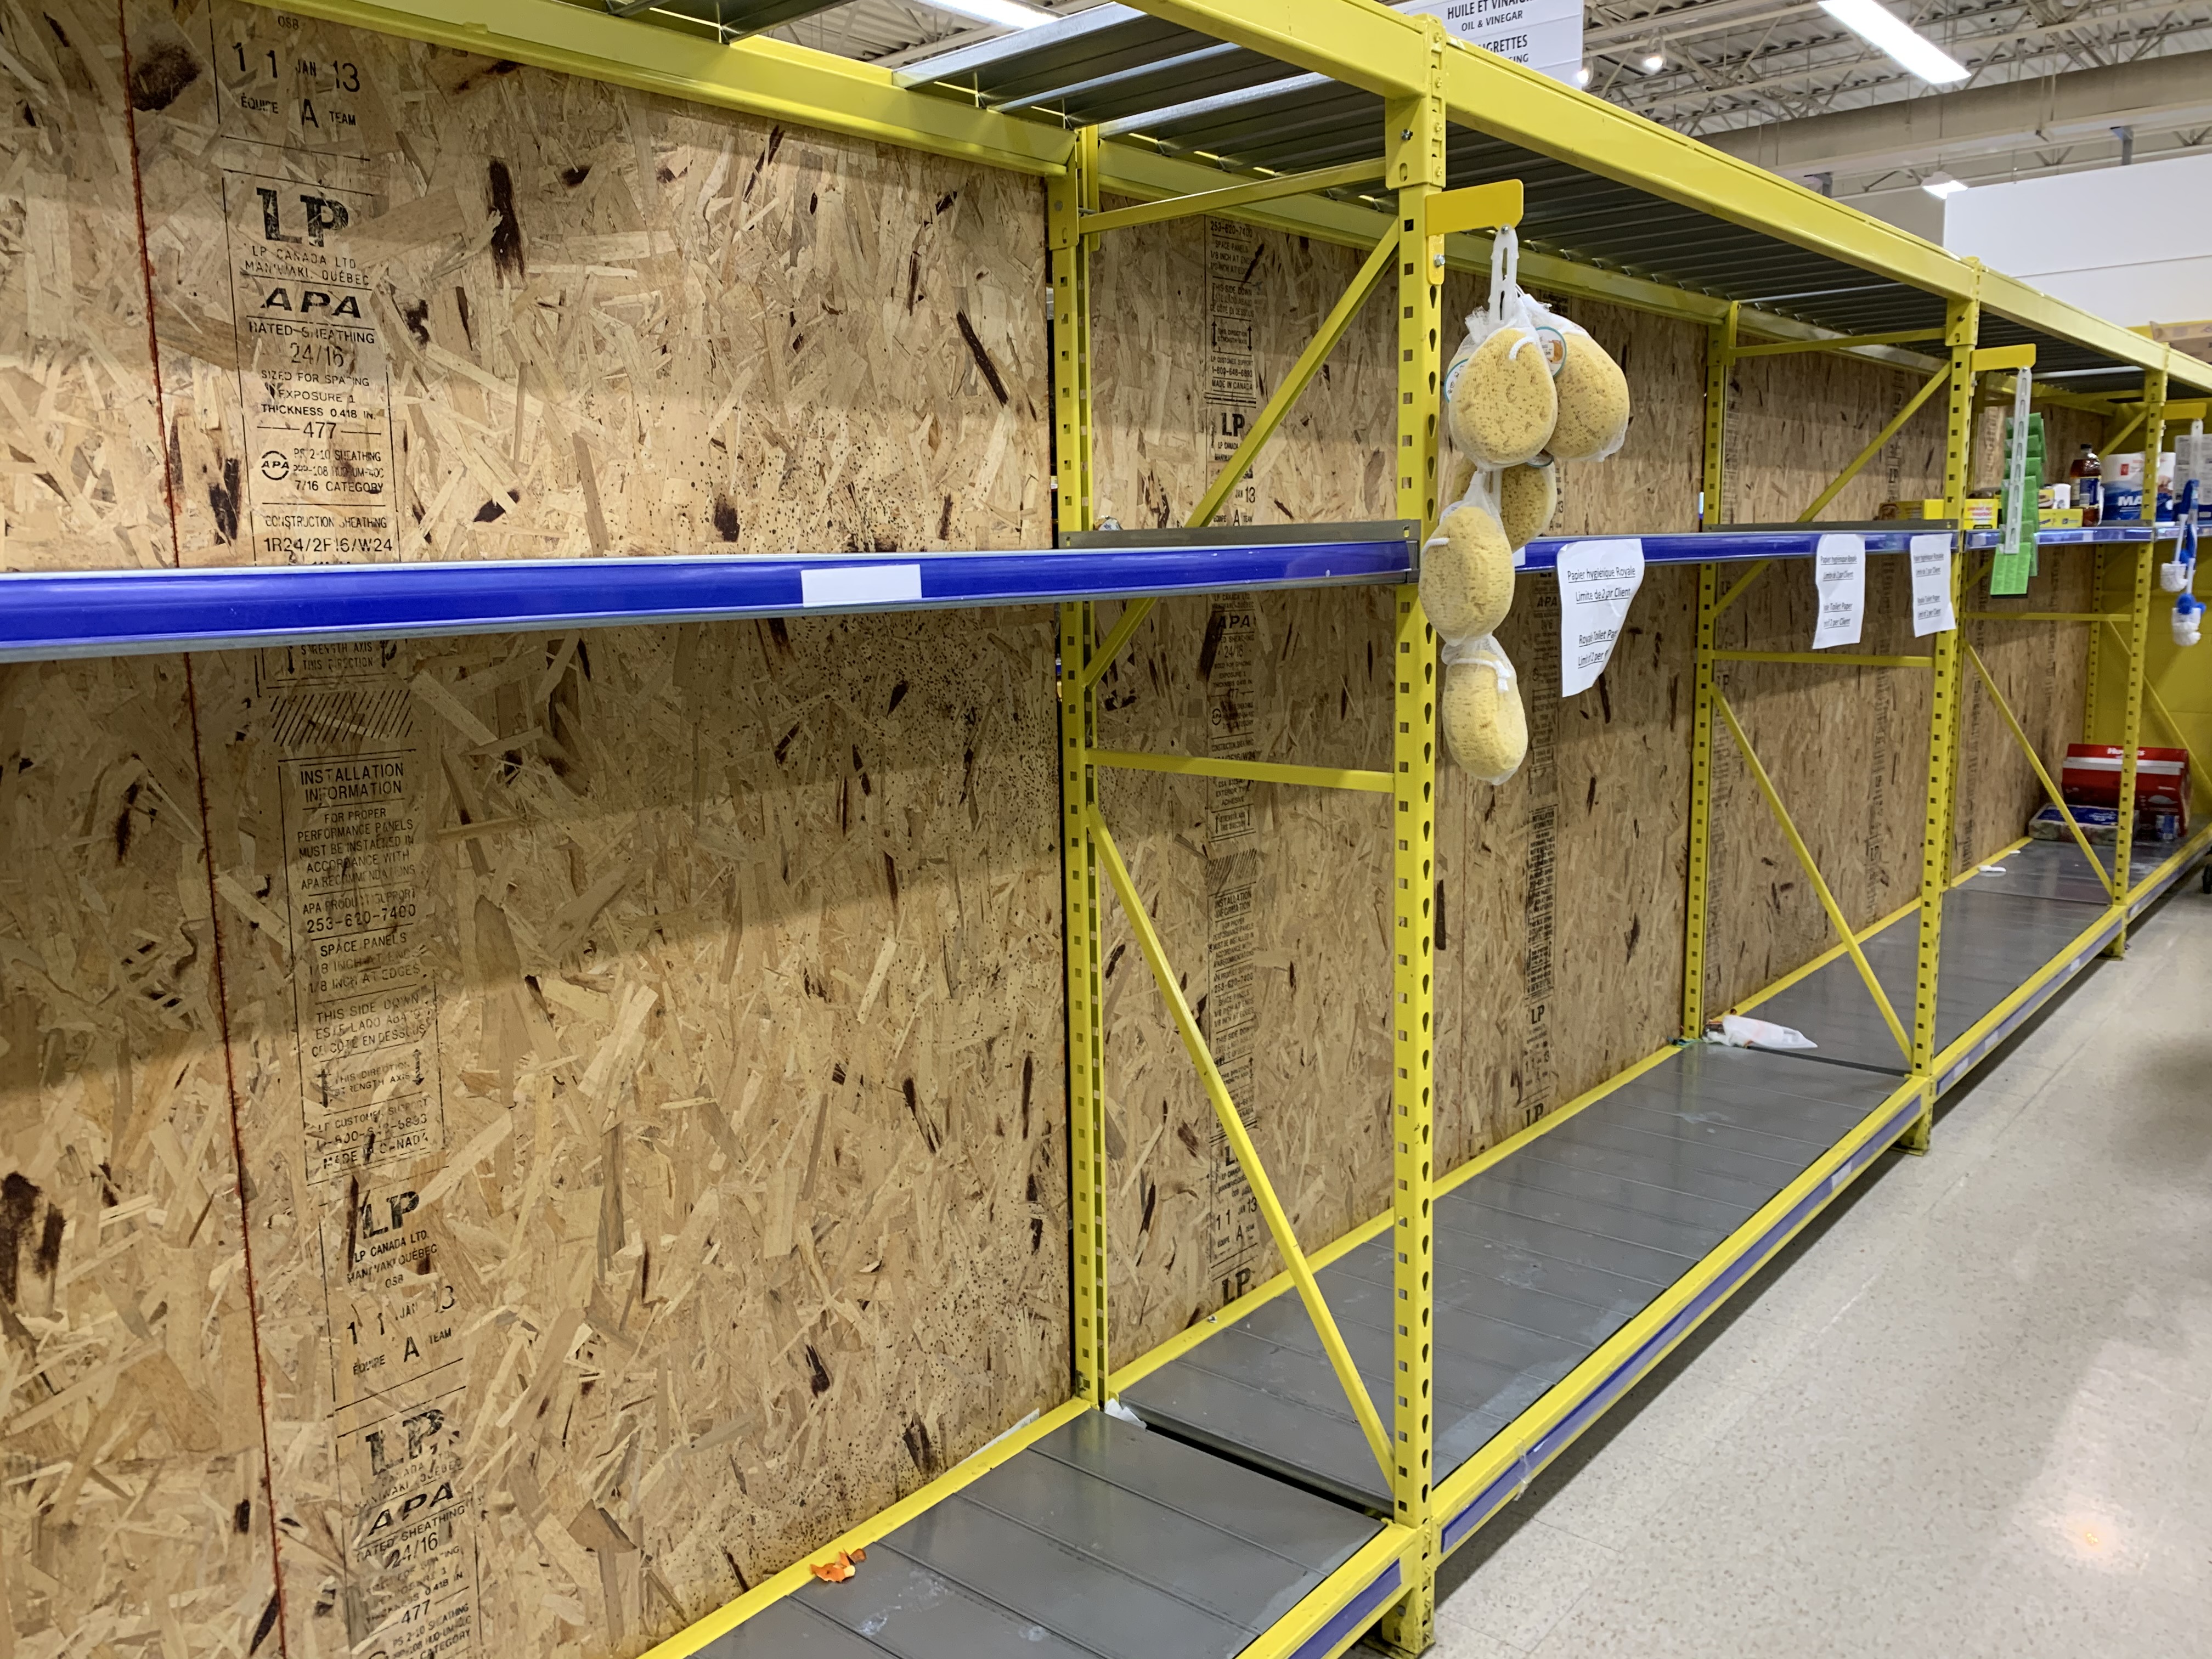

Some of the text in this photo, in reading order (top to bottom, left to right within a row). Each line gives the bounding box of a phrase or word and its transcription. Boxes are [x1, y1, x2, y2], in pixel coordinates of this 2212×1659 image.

[1447, 2, 1475, 20] HUILE
[1477, 0, 1488, 13] ET
[1461, 10, 1523, 31] OIL & VINEGAR
[278, 15, 299, 30] OSB
[295, 59, 317, 77] JAN
[332, 60, 360, 93] 13
[302, 98, 319, 128] A
[329, 110, 356, 126] TEAM
[256, 187, 349, 247] LP
[252, 245, 357, 269] LP CANADA LTD
[322, 269, 369, 286] QUÉBEC
[260, 286, 362, 319] APA
[249, 321, 375, 344] RATED SHEATHING
[290, 342, 344, 368] 24/16
[261, 370, 370, 386] SIZED FOR SPACING
[278, 389, 356, 403] EXPOSURE 1
[261, 403, 376, 420] THICKNESS 0.418 IN.
[302, 421, 337, 439] 477
[1221, 412, 1246, 437] LP
[261, 460, 290, 470] APA
[309, 448, 331, 460] 2-10
[335, 449, 381, 462] SHEATHING
[295, 480, 383, 493] 7/16 CATEGORY
[1245, 486, 1256, 504] 13
[2118, 495, 2142, 507] MA
[266, 515, 387, 529] CONSTRUCTION SHEATHING
[1233, 509, 1240, 527] A
[263, 537, 393, 553] 1R24/2F16/W24
[1567, 569, 1585, 582] Papier
[1616, 565, 1636, 578] Royale
[1576, 591, 1594, 602] Limite
[353, 641, 373, 653] AXIS
[301, 763, 404, 786] INSTALLATION
[304, 780, 402, 803] INFORMATION
[324, 808, 386, 823] FOR PROPER
[297, 819, 414, 843] PERFORMANCE PANELS
[299, 834, 414, 859] MUST BE INSTALLED IN
[307, 850, 410, 873] ACCORDANCE WITH
[301, 878, 320, 890] APA
[303, 904, 322, 915] APA
[307, 904, 416, 934] 253-620-7400
[320, 932, 407, 957] SPACE PANELS
[334, 958, 362, 972] INCH
[332, 975, 358, 989] INCH
[362, 970, 380, 983] AT
[382, 964, 421, 980] EDGES
[317, 992, 419, 1024] THIS SIDE DOWN
[1531, 1004, 1545, 1025] LP
[323, 1150, 358, 1170] MADE
[361, 1190, 420, 1240] LP
[354, 1250, 366, 1262] LP
[370, 1237, 407, 1257] CANADA
[398, 1243, 438, 1265] QUÉBEC
[1221, 1267, 1251, 1308] LP
[403, 1328, 452, 1363] A TEAM
[365, 1408, 445, 1477] LP
[367, 1481, 454, 1538] APA
[402, 1505, 465, 1542] SHEATHING
[401, 1599, 431, 1624] 477
